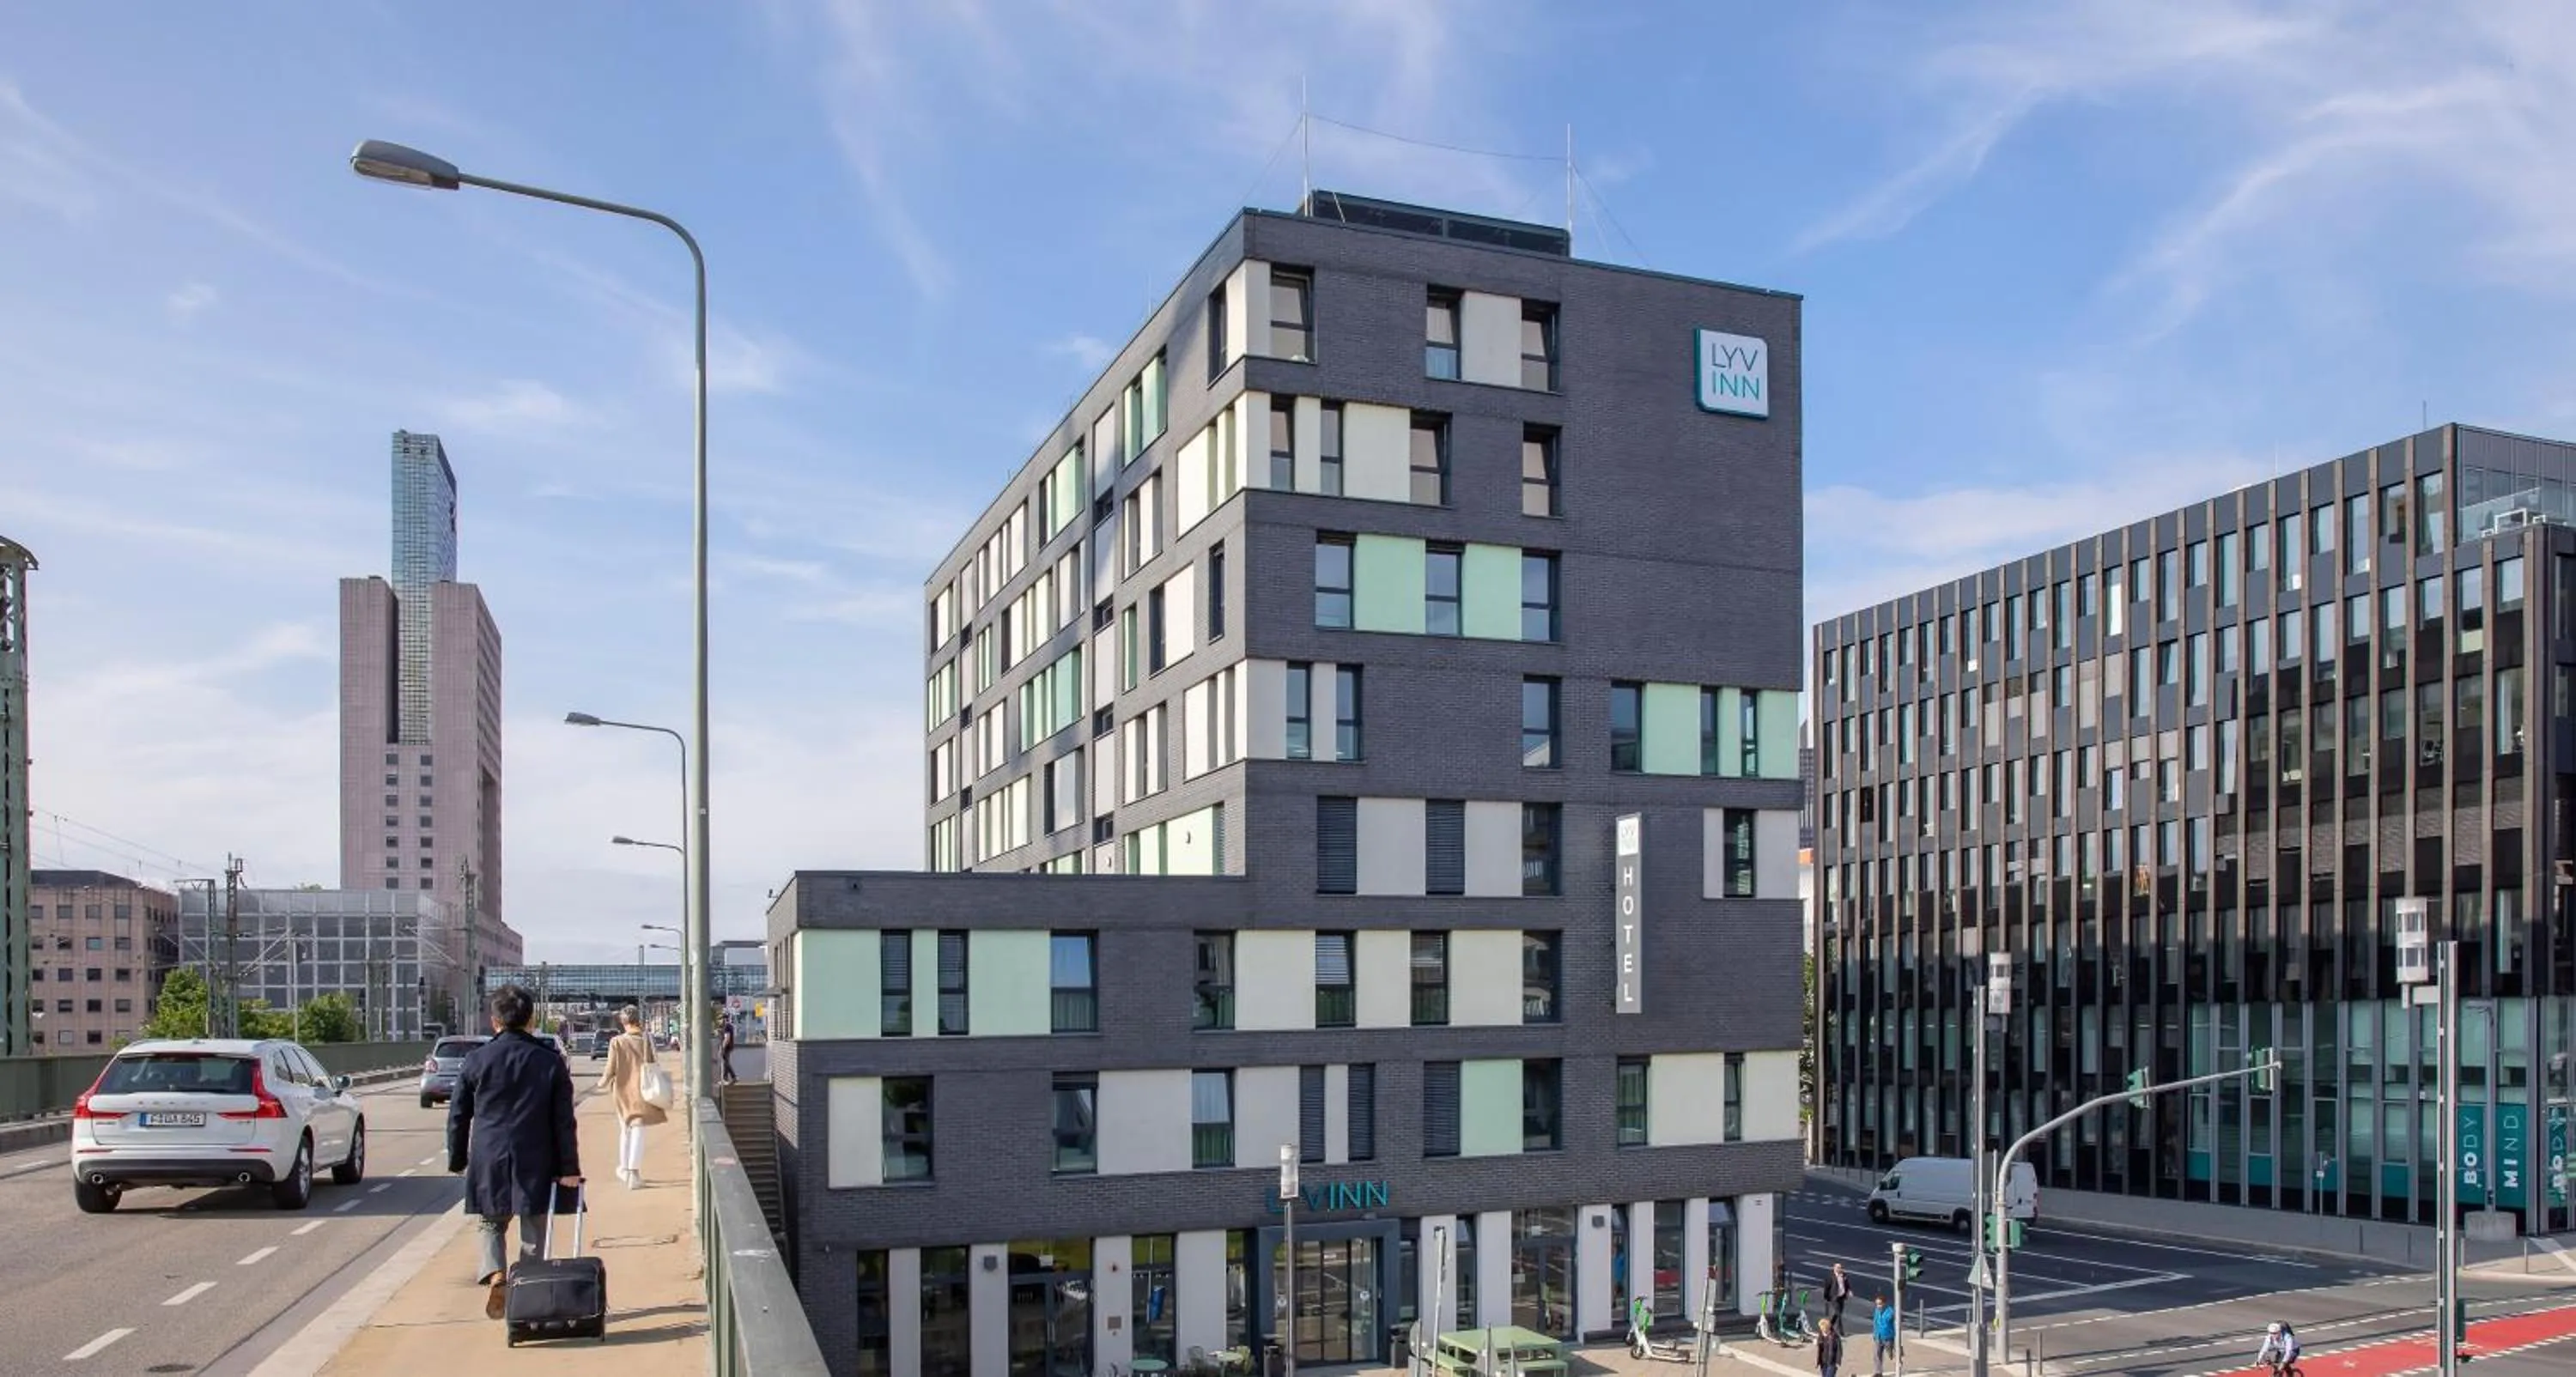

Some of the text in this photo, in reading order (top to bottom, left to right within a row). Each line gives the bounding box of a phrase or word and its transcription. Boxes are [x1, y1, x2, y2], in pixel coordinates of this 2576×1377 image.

[1712, 343, 1758, 371] LYV
[1713, 371, 1759, 400] INN
[1622, 867, 1634, 1002] HOTEL
[2464, 1117, 2477, 1184] BODY
[2503, 1115, 2518, 1187] MIND
